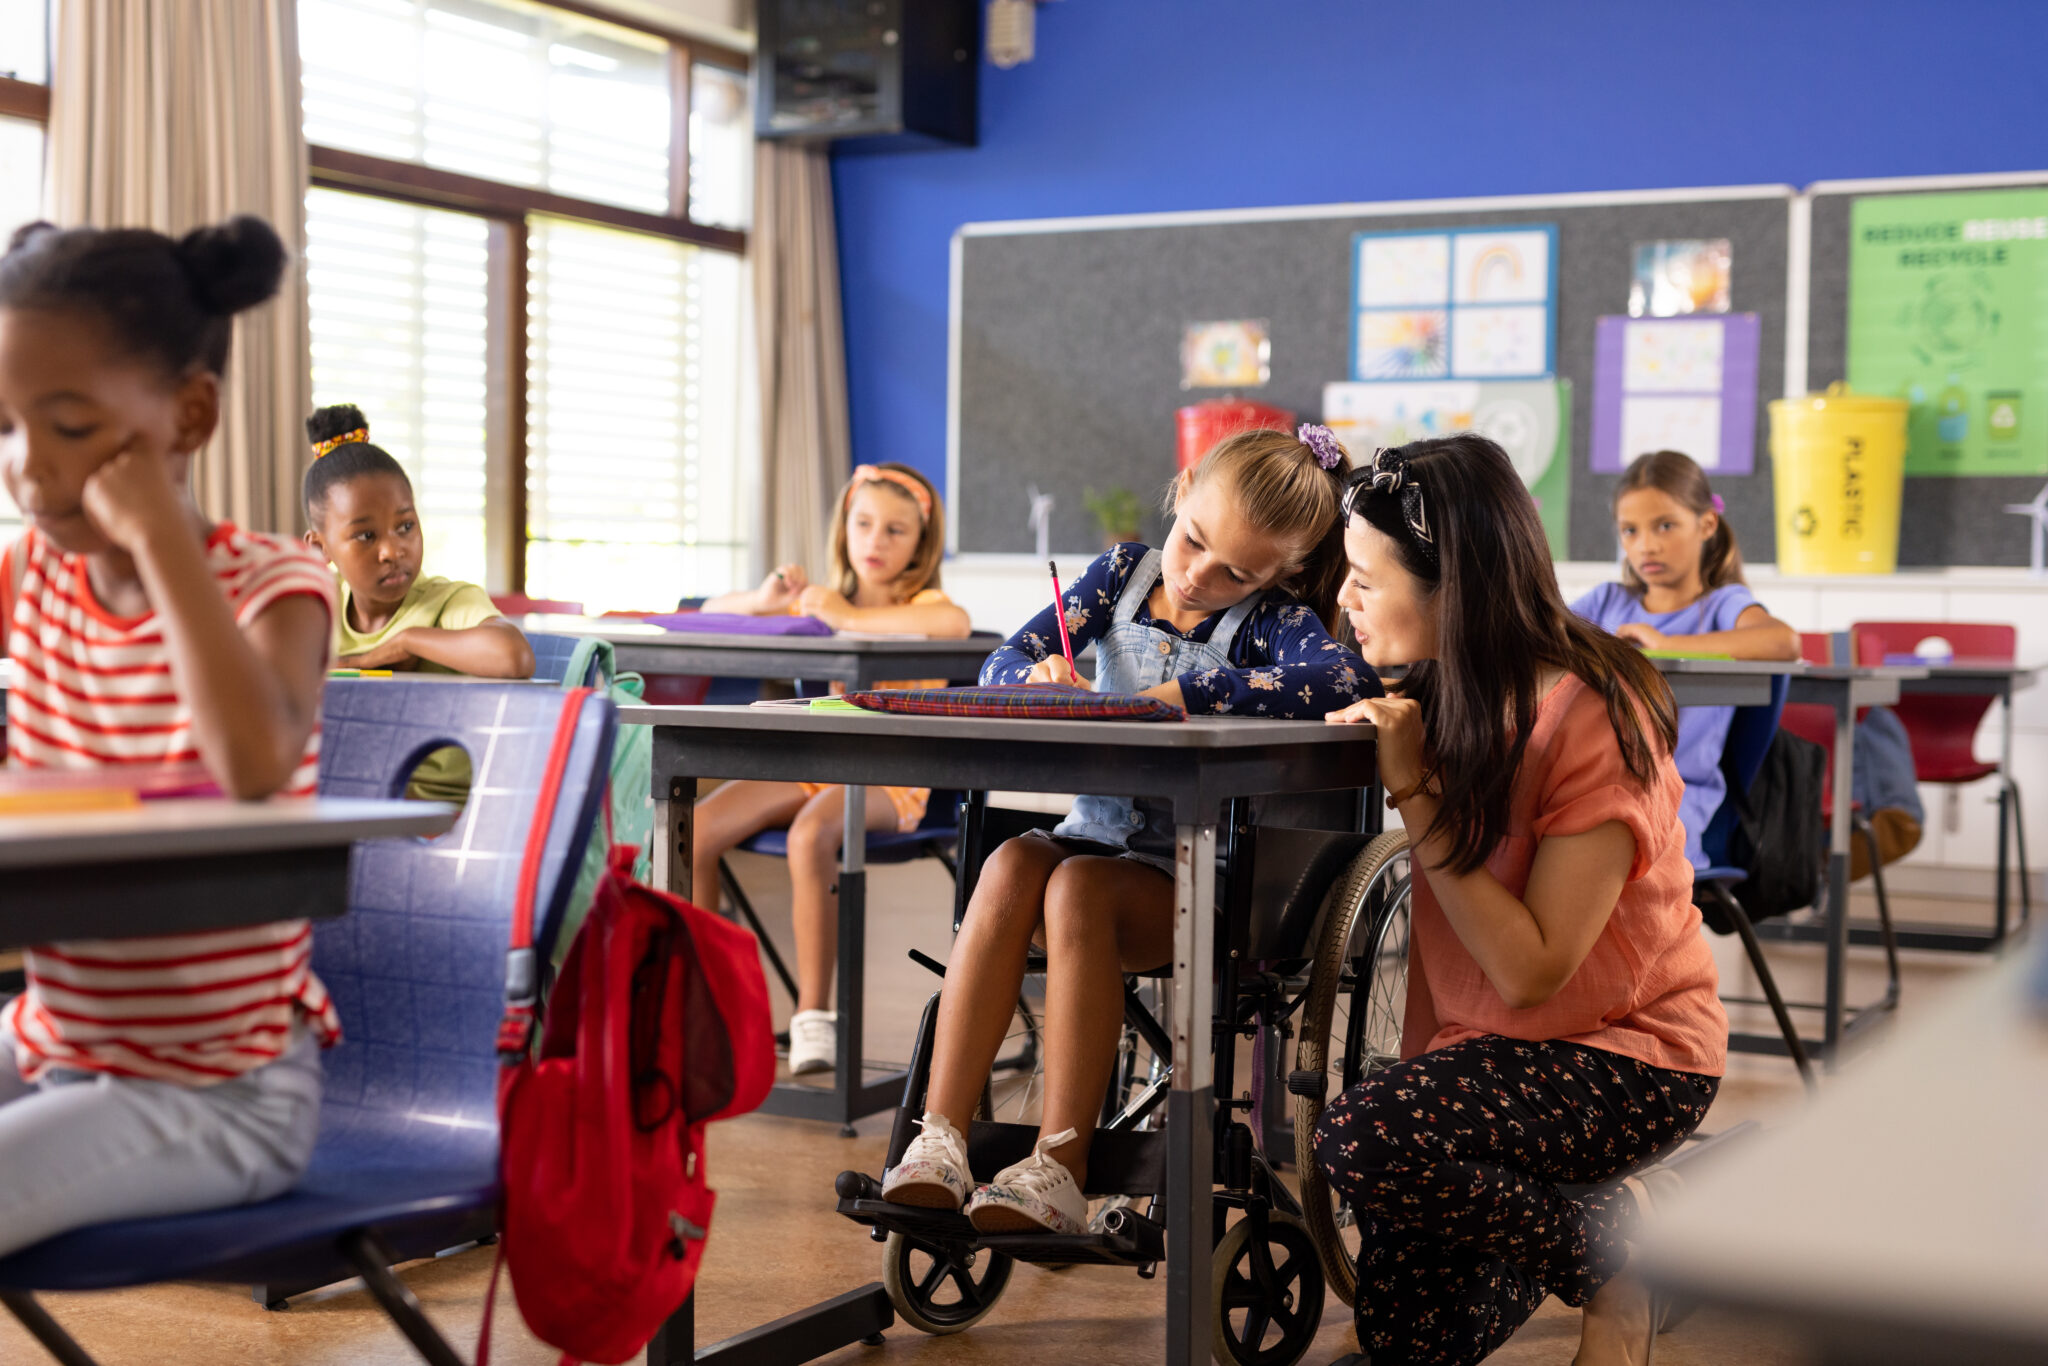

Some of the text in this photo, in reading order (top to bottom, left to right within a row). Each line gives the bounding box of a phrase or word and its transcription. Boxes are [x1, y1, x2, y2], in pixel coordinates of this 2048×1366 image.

[1863, 217, 2048, 242] REDUCE REUSE
[1899, 246, 2007, 268] RECYCLE
[1844, 436, 1863, 539] PLASTIC
